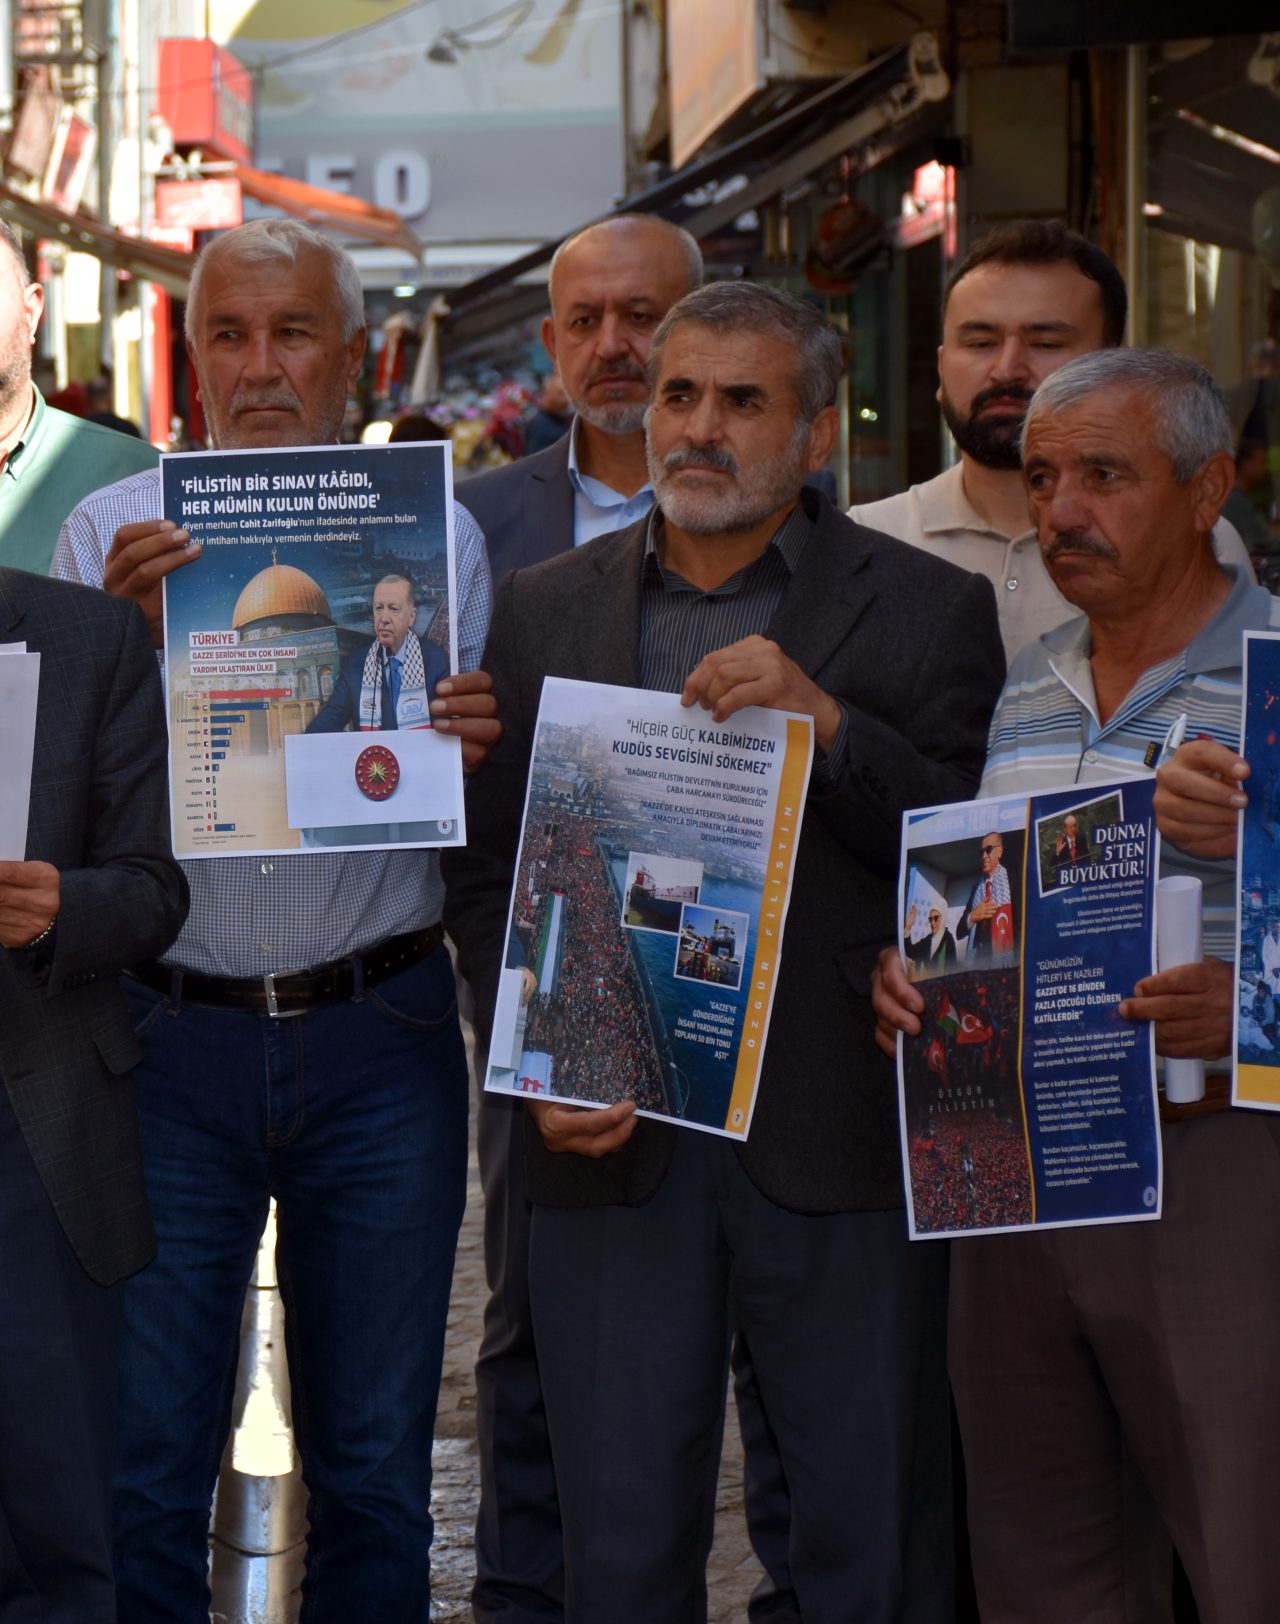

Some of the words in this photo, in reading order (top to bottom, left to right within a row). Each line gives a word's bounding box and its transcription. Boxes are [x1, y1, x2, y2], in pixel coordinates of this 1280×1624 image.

[182, 475, 241, 494] 'FİLİSTİN
[245, 473, 269, 491] BİR
[272, 475, 316, 490] SINAV
[319, 470, 372, 489] KÂĞIDI,
[182, 500, 210, 515] HER
[214, 495, 262, 514] MÜMİN
[266, 496, 314, 512] KULUN
[317, 492, 380, 510] ÖNÜNDE'
[182, 521, 204, 532] diyen
[205, 520, 238, 530] merhum
[240, 519, 260, 529] Cahit
[262, 517, 315, 529] Zarifoğlu'nun
[316, 516, 358, 526] ifadesinde
[359, 514, 393, 525] anlamını
[394, 513, 417, 524] bulan
[206, 534, 239, 545] imtihanı
[240, 534, 273, 545] hakkıyla
[274, 533, 312, 543] vermenin
[313, 531, 362, 543] derdindeyiz.
[191, 631, 235, 646] TÜRKİYE
[192, 651, 214, 660] GAZZE
[248, 650, 257, 658] EN
[258, 649, 272, 658] ÇOK
[273, 647, 296, 657] İNSANİ
[192, 666, 218, 674] YARDIM
[218, 664, 256, 674] ULAŞTIRAN
[256, 663, 273, 672] ÜLKE
[627, 719, 669, 739] "HİÇBİR
[671, 725, 696, 744] GÜÇ
[698, 730, 776, 754] KALBİMİZDEN
[612, 740, 653, 758] KUDÜS
[655, 746, 714, 767] SEVGİSİNİ
[716, 753, 772, 775] SÖKEMEZ"
[658, 770, 684, 782] FİLİSTİN
[666, 785, 684, 795] ÇABA
[1096, 823, 1146, 844] DÜNYA
[1104, 841, 1145, 861] 5'TEN
[1060, 859, 1145, 885] BÜYÜKTÜR!
[1063, 971, 1073, 981] VE
[1035, 985, 1068, 998] GAZZE'DE
[1069, 984, 1077, 993] 16
[1077, 981, 1106, 993] BİNDEN
[1035, 1000, 1056, 1011] FAZLA
[1057, 995, 1086, 1010] ÇOCUĞU
[1086, 993, 1122, 1005] ÖLDÜREN
[735, 1113, 740, 1122] 7
